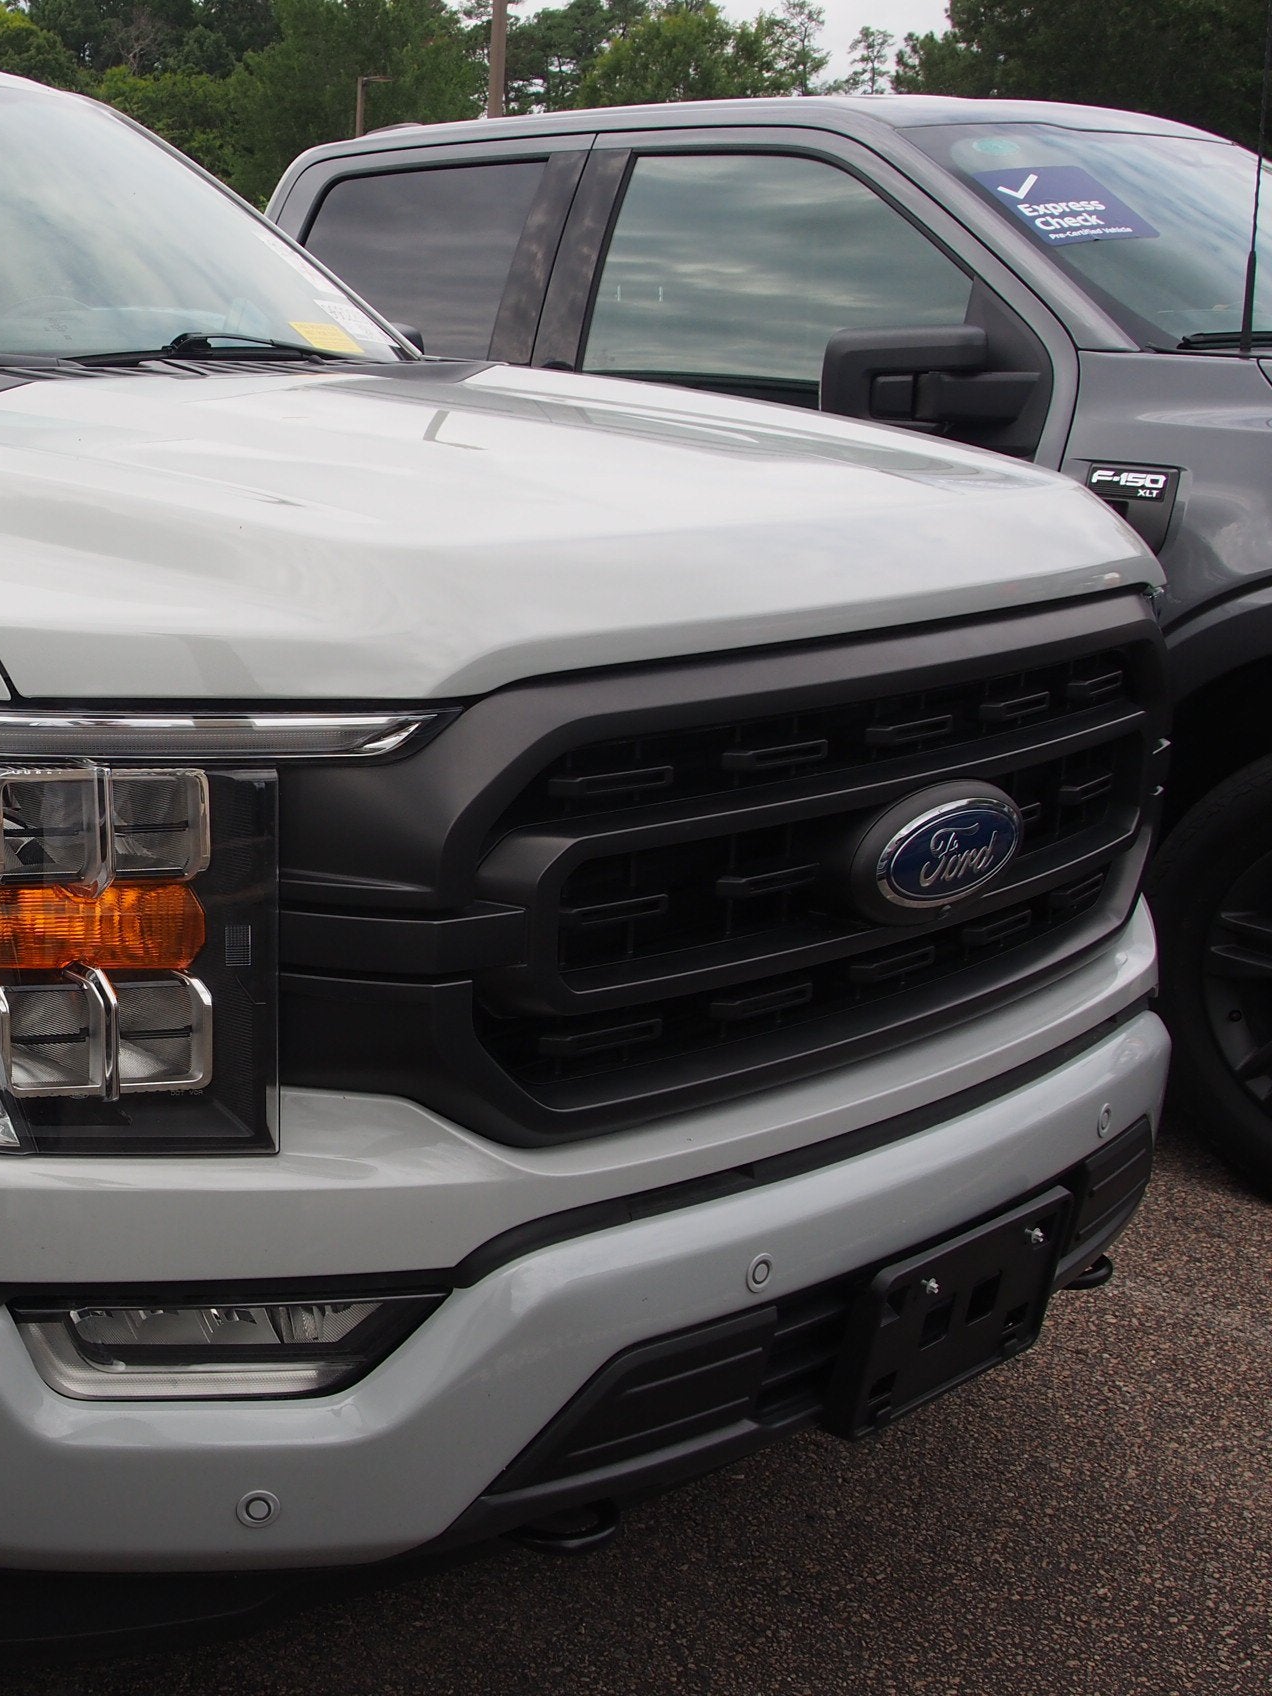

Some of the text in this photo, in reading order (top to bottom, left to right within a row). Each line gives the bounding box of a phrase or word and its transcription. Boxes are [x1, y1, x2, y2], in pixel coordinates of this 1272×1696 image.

[1017, 200, 1106, 217] Express
[1035, 213, 1105, 231] Check
[1048, 226, 1133, 240] Pre-Certified Vehicle
[1091, 470, 1167, 489] F-150
[1137, 489, 1160, 498] XLT
[919, 822, 998, 887] Ford
